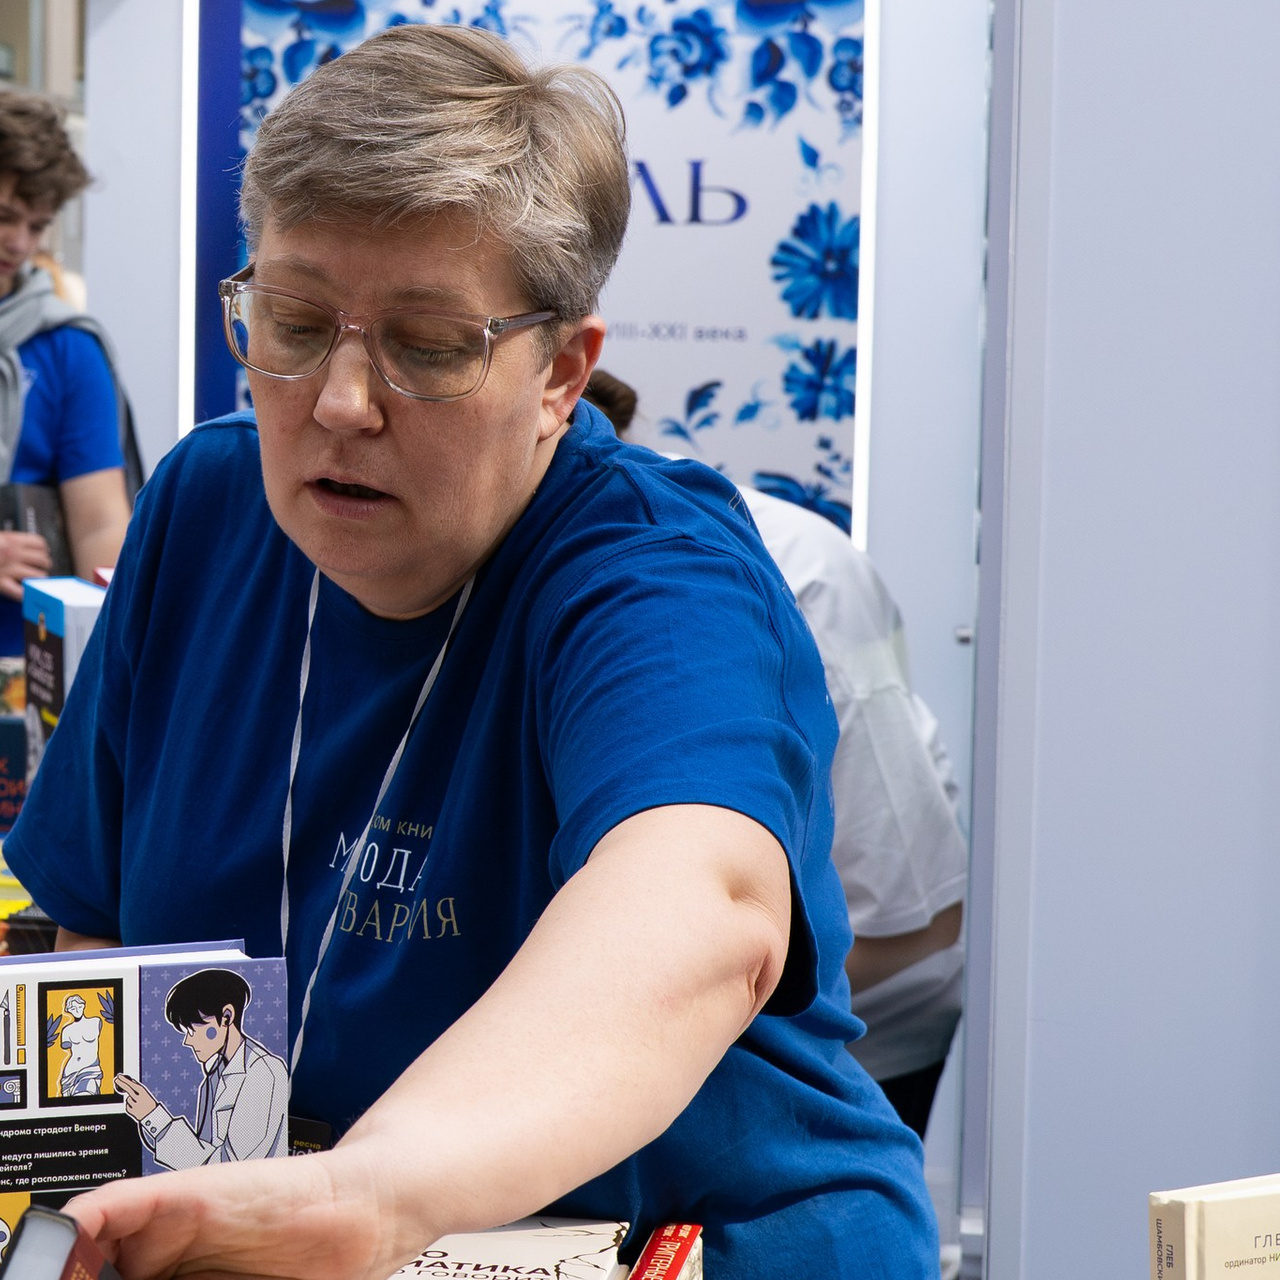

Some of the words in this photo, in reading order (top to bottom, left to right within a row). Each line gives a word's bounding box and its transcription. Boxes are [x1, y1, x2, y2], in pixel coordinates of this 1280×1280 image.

[33, 1124, 72, 1137] страдает
[74, 1122, 106, 1132] Венера
[1, 1151, 32, 1163] недуга
[33, 1149, 76, 1159] лишились
[78, 1147, 109, 1158] зрения
[15, 1177, 30, 1185] где
[31, 1172, 97, 1185] расположена
[99, 1169, 127, 1179] печень?
[1166, 1243, 1174, 1268] ГЛЕБ
[1224, 1255, 1267, 1269] ординатор
